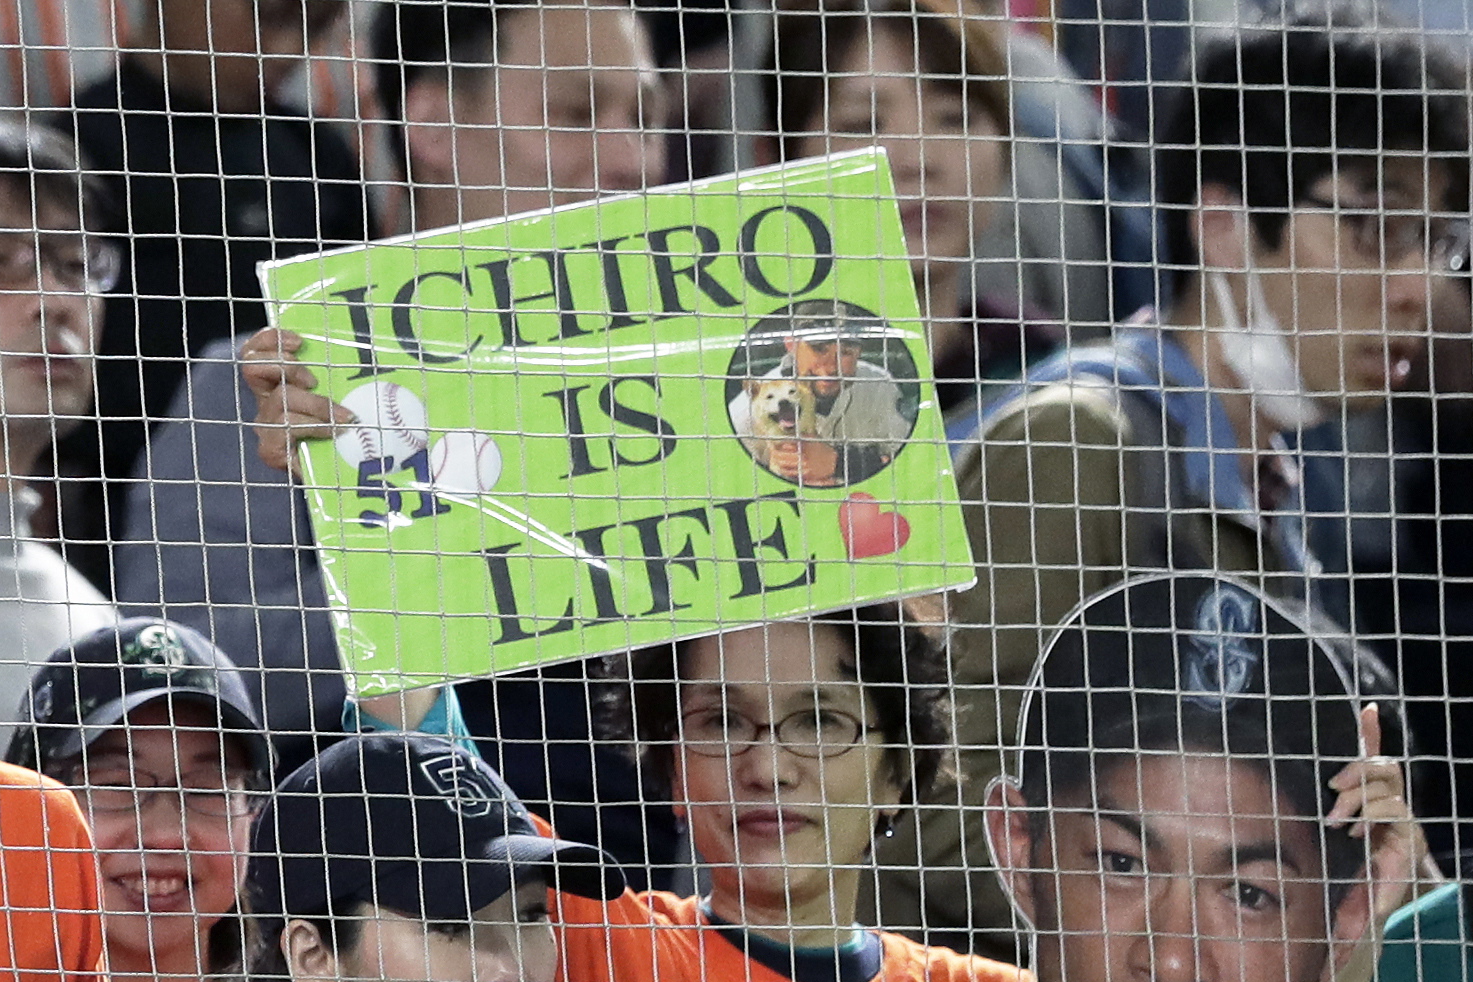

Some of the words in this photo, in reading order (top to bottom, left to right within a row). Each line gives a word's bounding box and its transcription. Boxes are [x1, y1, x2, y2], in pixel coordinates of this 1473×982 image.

[331, 205, 834, 381] ICHIRO
[356, 448, 451, 528] 51
[542, 375, 677, 479] IS
[472, 490, 818, 645] LIFE
